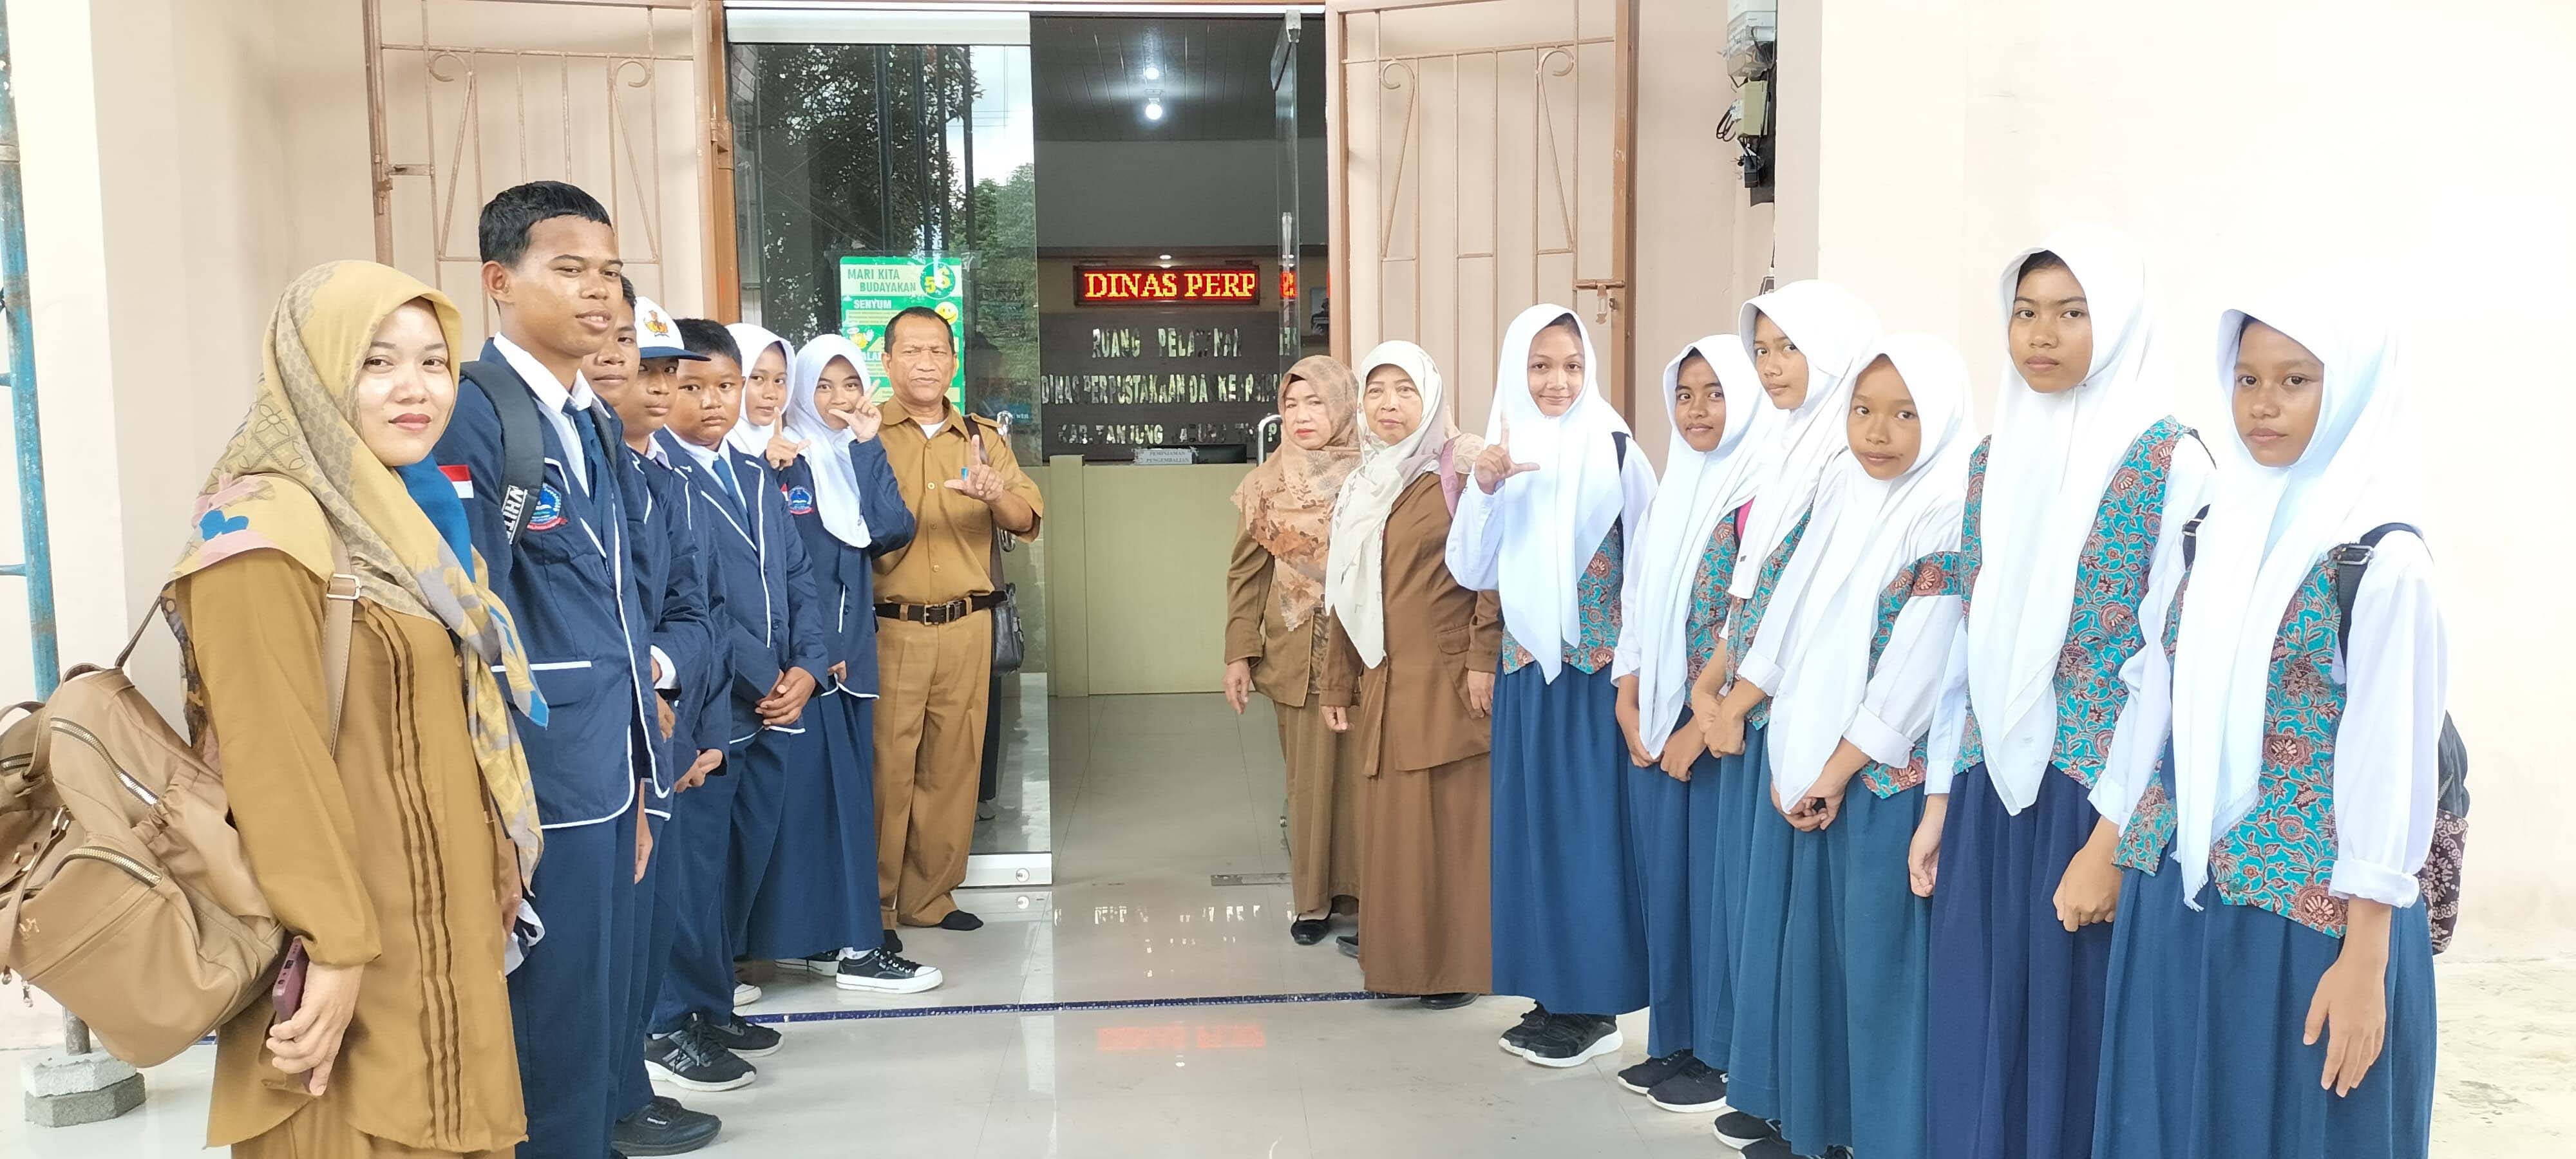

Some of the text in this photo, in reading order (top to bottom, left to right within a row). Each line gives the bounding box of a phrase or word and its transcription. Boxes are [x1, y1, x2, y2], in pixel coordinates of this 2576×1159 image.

[848, 269, 900, 279] MARI KITA
[860, 281, 916, 293] BUDAYAKAN
[1084, 273, 1177, 297] DINAS
[1184, 273, 1255, 297] PERP
[853, 299, 892, 309] SENYUM
[1092, 328, 1141, 358] RUANG
[1041, 374, 1080, 404] DINAS
